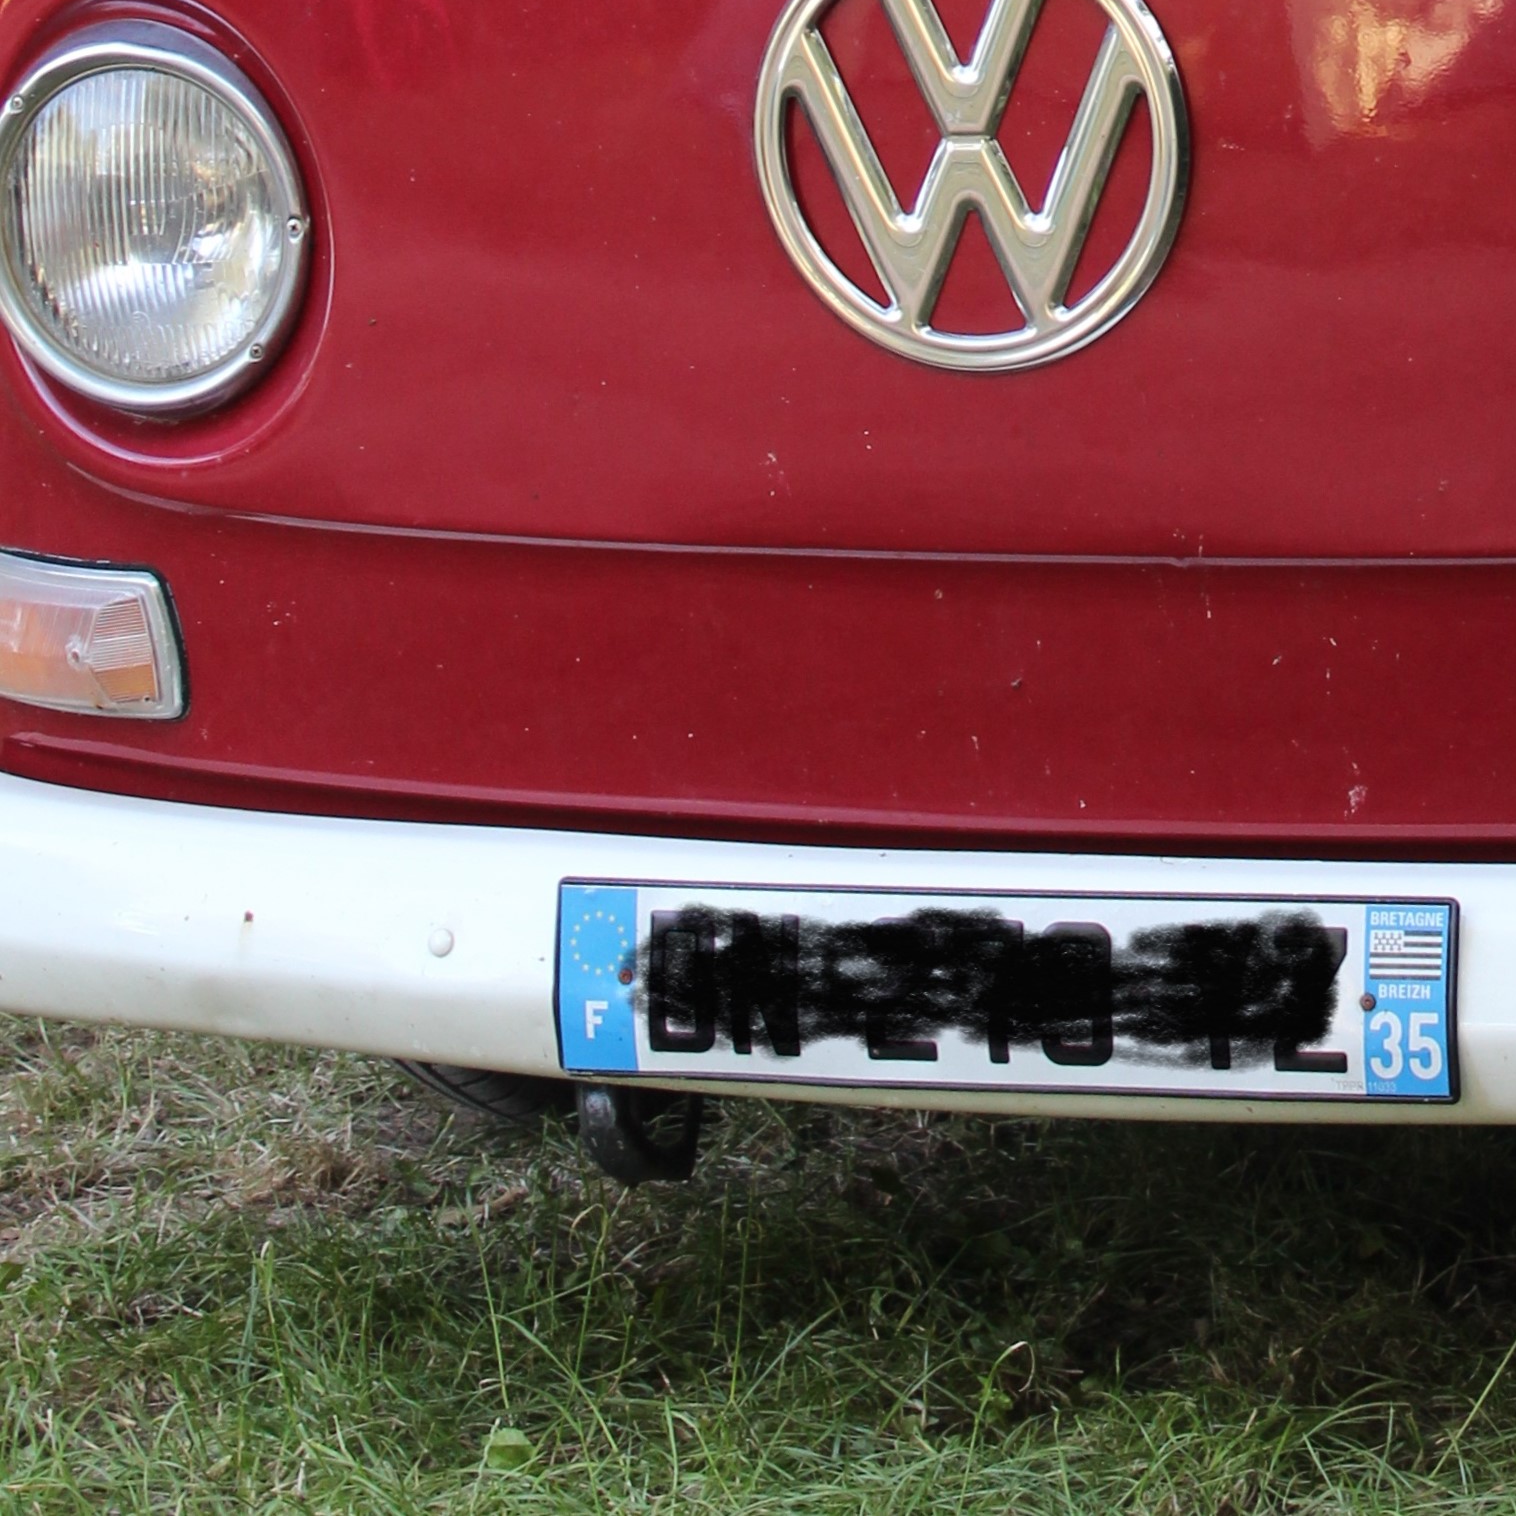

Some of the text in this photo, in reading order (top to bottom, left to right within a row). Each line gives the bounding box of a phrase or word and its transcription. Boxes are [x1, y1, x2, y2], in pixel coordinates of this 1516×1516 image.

[1370, 911, 1444, 928] BRETAGNE
[1378, 983, 1431, 1000] BREIZH
[585, 1000, 609, 1039] F
[1369, 1010, 1443, 1081] 35
